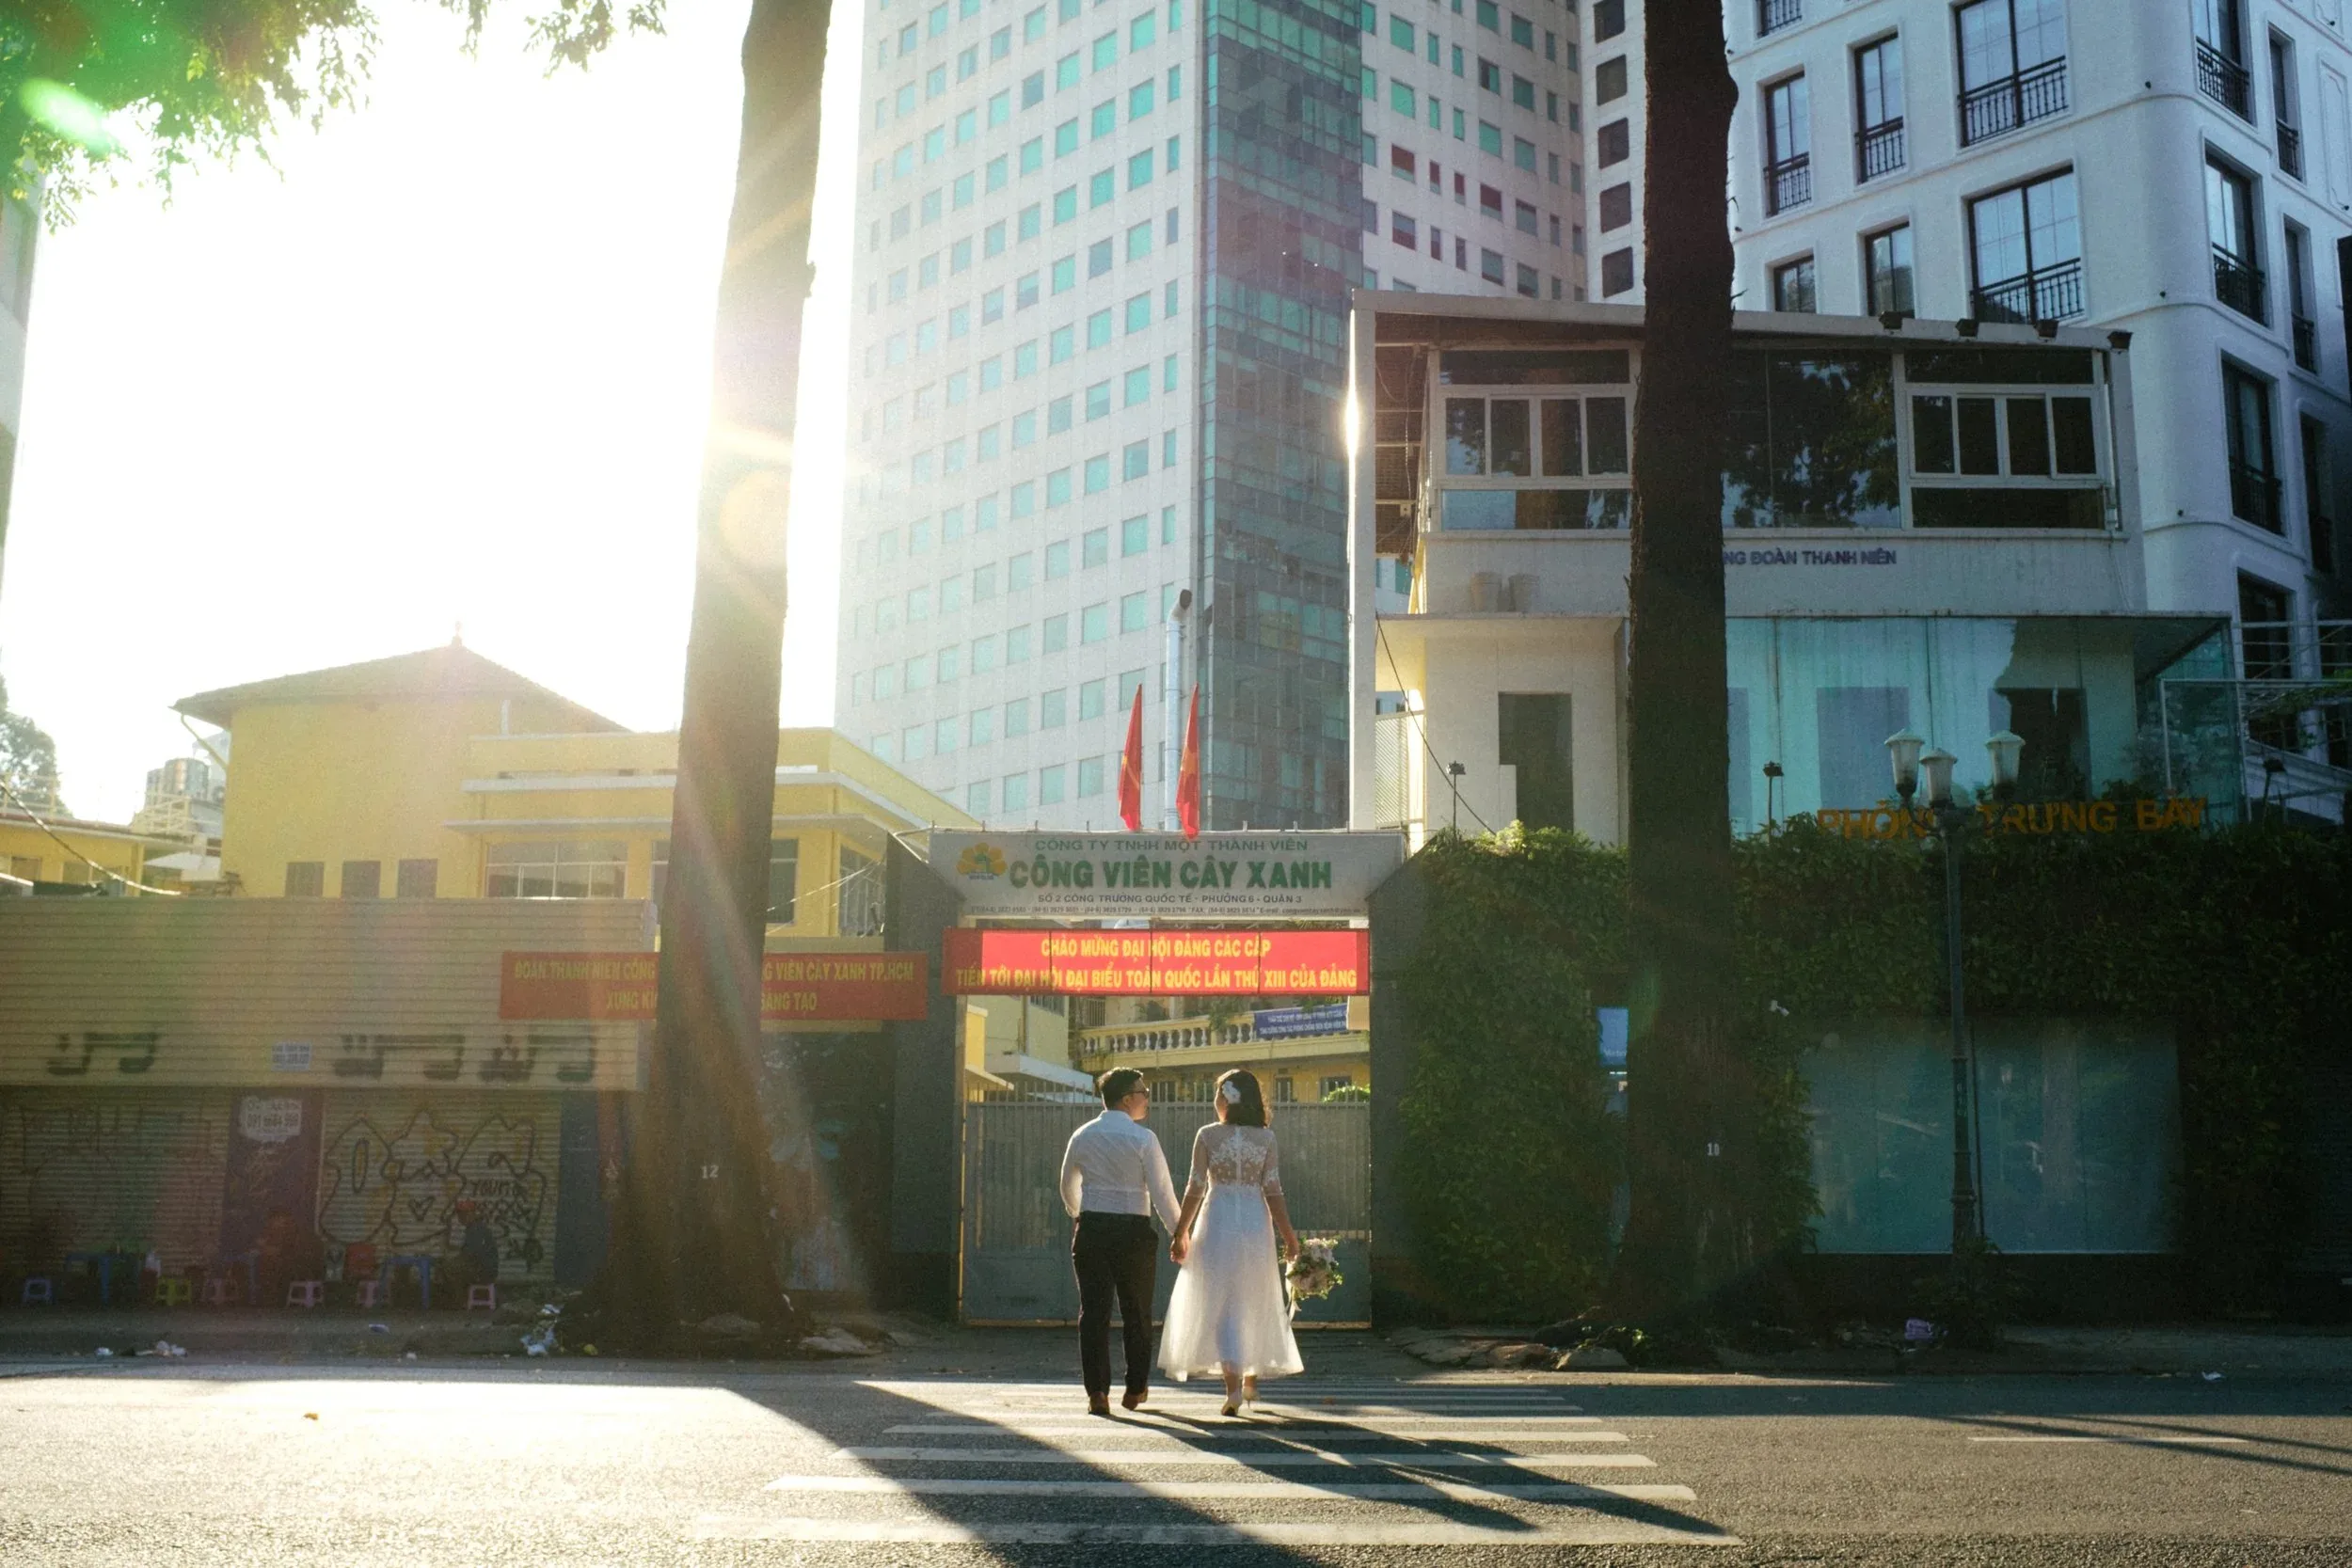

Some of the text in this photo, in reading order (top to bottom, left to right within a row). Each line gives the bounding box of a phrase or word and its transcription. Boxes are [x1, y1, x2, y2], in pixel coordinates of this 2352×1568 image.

[1750, 546, 1798, 565] ĐOÀN
[1802, 550, 1857, 565] THANH
[1860, 546, 1898, 565] NIÊN
[1977, 800, 2118, 836] TRƯNG
[1035, 835, 1308, 853] CÔNG TY TNHH MỘT THÀNH VIÊN
[1009, 854, 1332, 889] CÔNG VIÊN CÂY XANH
[1038, 892, 1053, 904] SỐ
[1056, 895, 1062, 904] 2
[1064, 892, 1094, 904] CÔNG
[1145, 892, 1176, 904] QUỐC
[1248, 895, 1255, 904] 6
[1295, 895, 1303, 904] 3
[1041, 933, 1272, 962] CHÀO MỪNG ĐẠI HỘI ĐẢNG CÁC CẤP
[623, 957, 656, 979] CÔNG
[762, 961, 773, 980] G
[776, 958, 803, 980] VIÊN
[834, 961, 866, 980] XANH
[956, 961, 1357, 991] TIẾN TỚI ĐẠI HỘI ĐẠI BIỂU TOÀN QUỐC LẦN THỨ XIII CỦA ĐẢNG
[607, 990, 639, 1009] XUNG
[700, 1164, 720, 1180] 12
